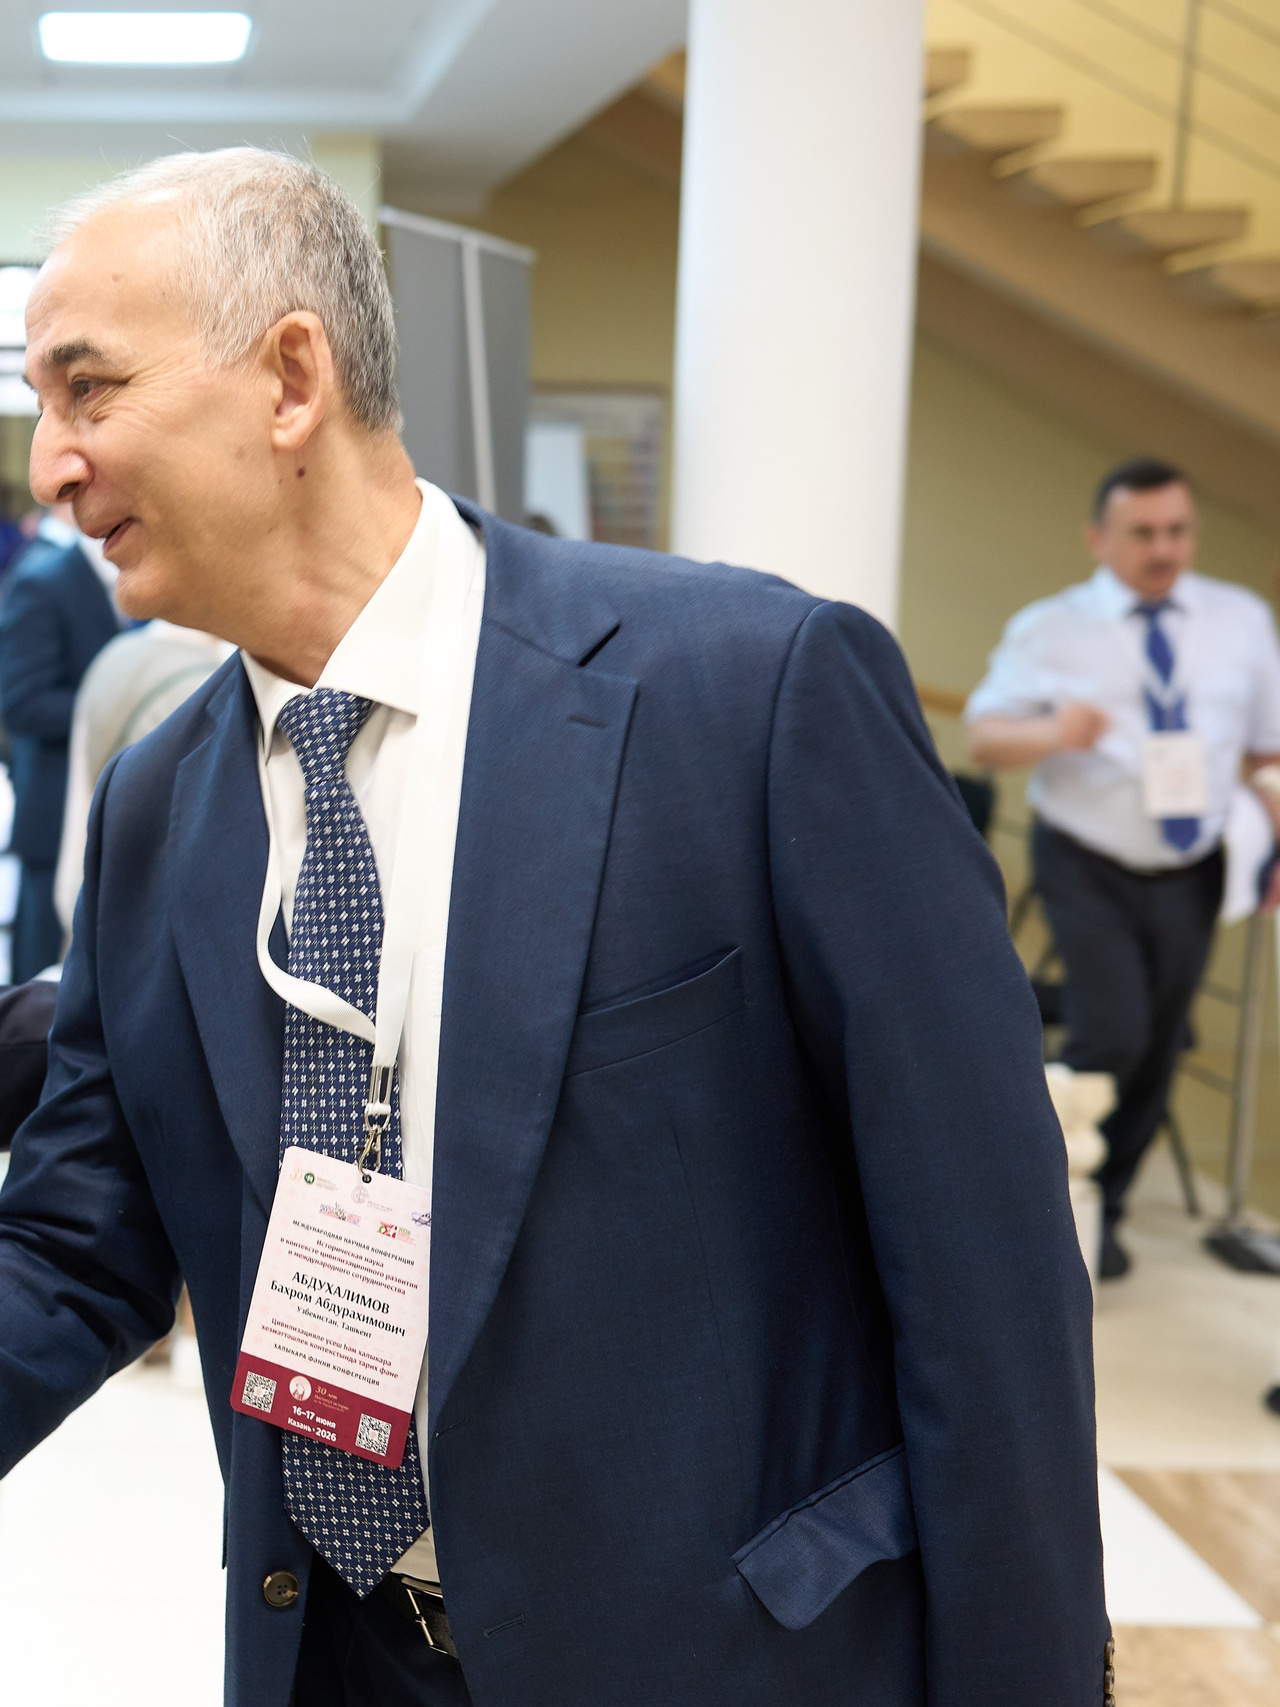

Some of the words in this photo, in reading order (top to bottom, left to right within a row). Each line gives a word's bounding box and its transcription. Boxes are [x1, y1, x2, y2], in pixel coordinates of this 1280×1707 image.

[292, 1220, 342, 1242] МЕЖДУНАРОДНАЯ
[344, 1237, 370, 1251] НАУЧНАЯ
[371, 1246, 415, 1266] КОНФЕРЕНЦИЯ
[316, 1239, 363, 1261] Историческая
[364, 1256, 384, 1269] наука
[286, 1240, 319, 1255] контексте
[320, 1250, 384, 1278] цивилизационного
[385, 1274, 418, 1290] развития
[294, 1251, 351, 1276] международного
[351, 1272, 406, 1296] сотрудничества
[270, 1280, 312, 1304] Бахром
[314, 1296, 406, 1338] Абдурахимович
[292, 1272, 390, 1315] АБДУХАЛИМОВ
[296, 1306, 339, 1328] Узбекистан,
[341, 1321, 372, 1339] Ташкент
[274, 1343, 307, 1360] ХАЛЫКАРА
[332, 1362, 380, 1387] КОНФЕРЕНЦИЯ
[358, 1358, 378, 1372] тарих
[315, 1386, 327, 1396] 30
[288, 1417, 312, 1432] Казань
[316, 1427, 337, 1442] 2026
[316, 1416, 336, 1430] июня
